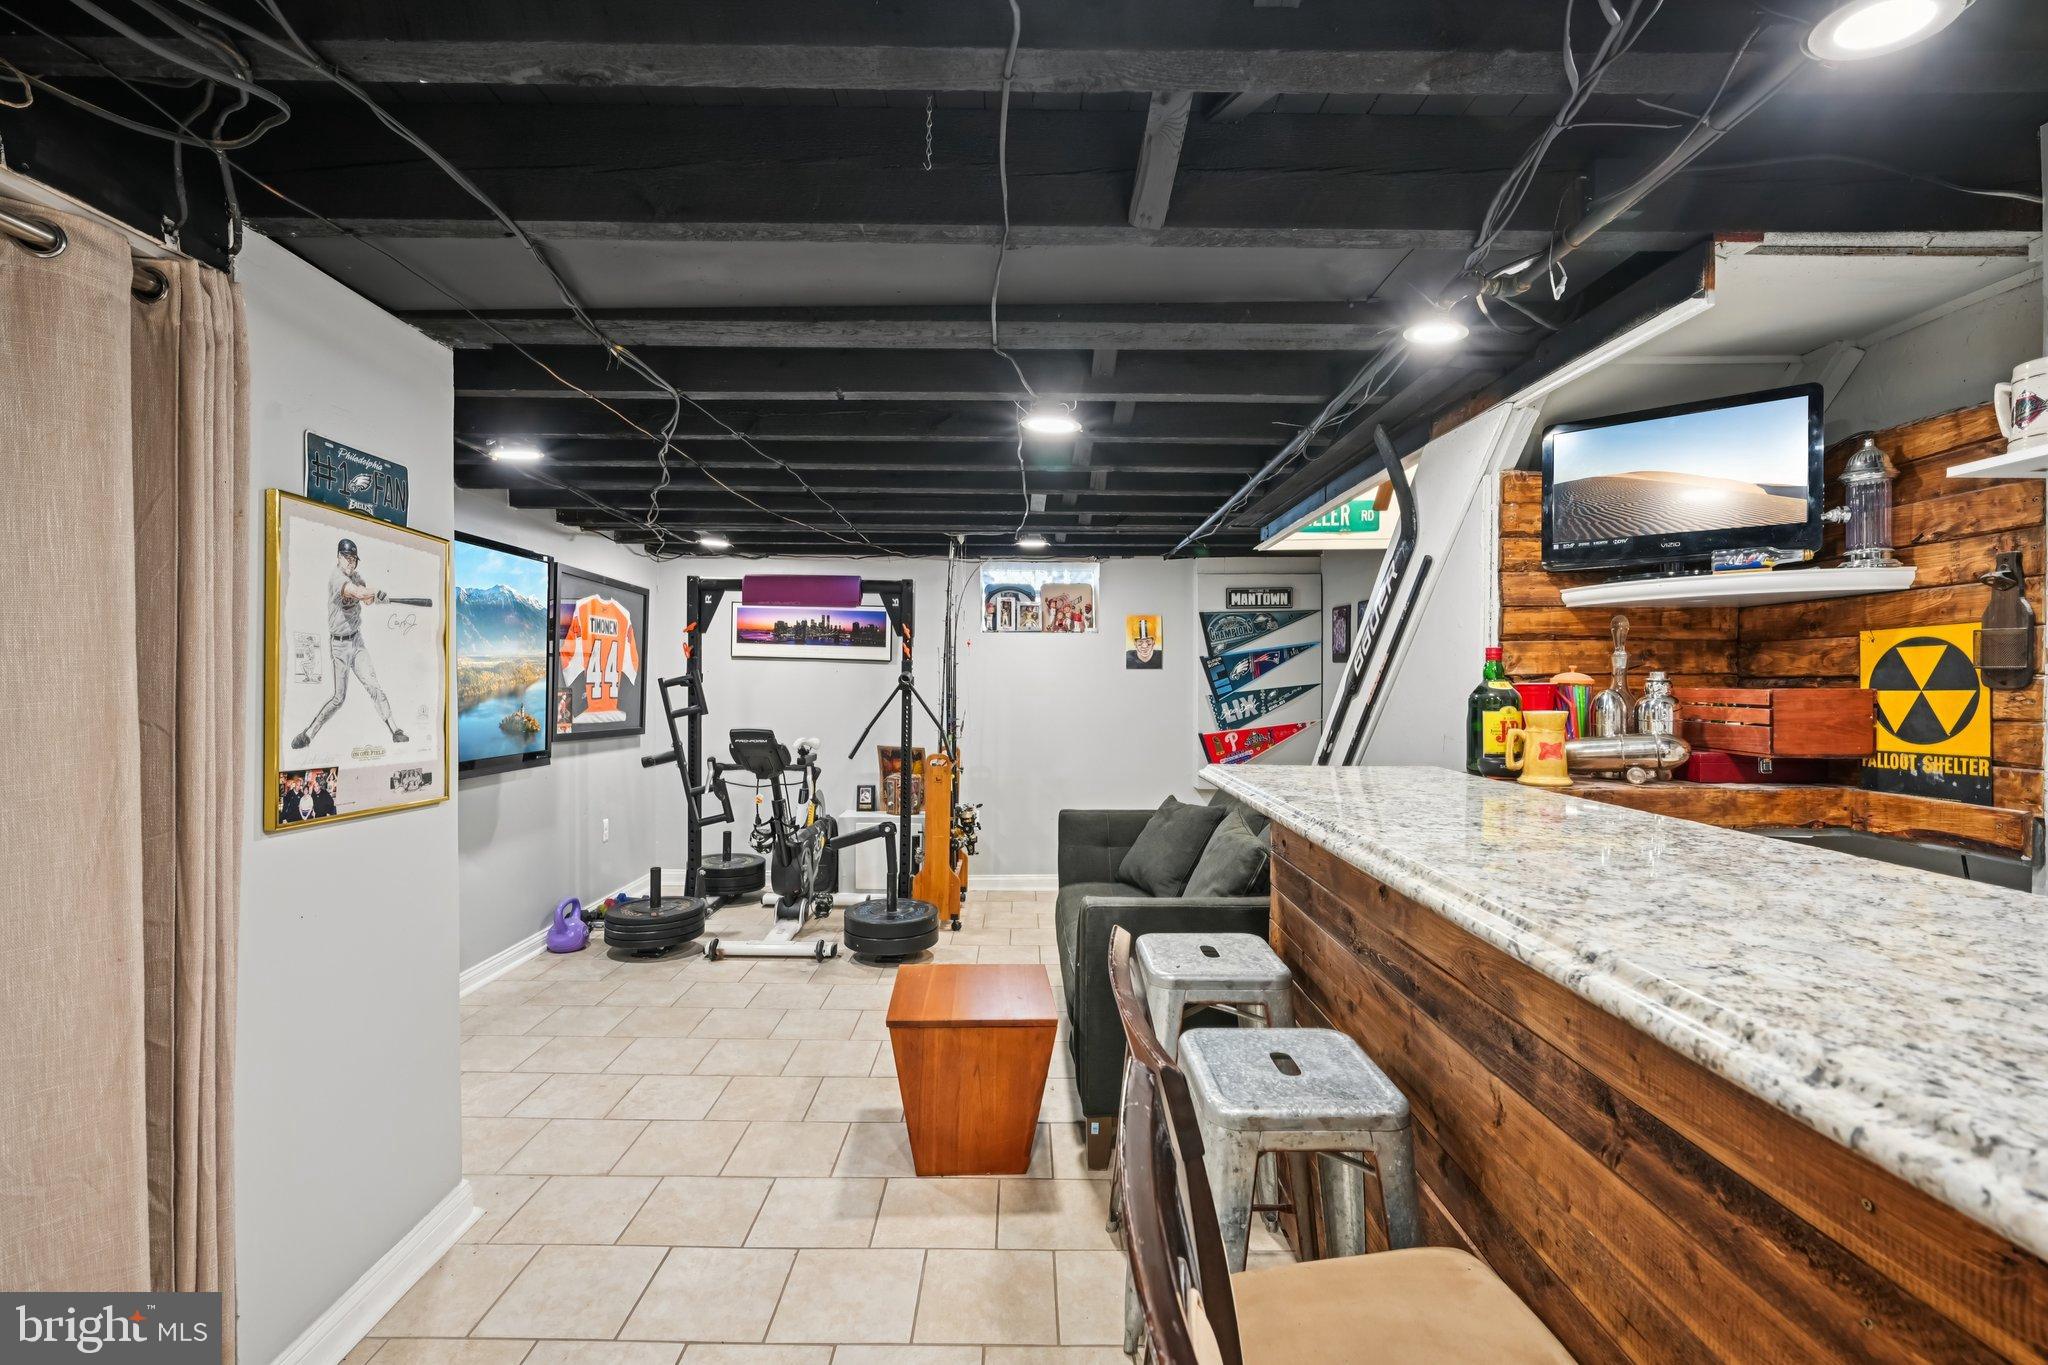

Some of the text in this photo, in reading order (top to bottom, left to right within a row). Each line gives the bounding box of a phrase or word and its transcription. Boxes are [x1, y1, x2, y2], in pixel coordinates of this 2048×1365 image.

[338, 447, 383, 471] Philadelphia
[312, 450, 406, 511] #1 FAN
[348, 499, 374, 516] EAGLES
[1361, 509, 1375, 521] RD
[1231, 592, 1288, 606] MANTOWN
[589, 616, 618, 635] TIMONEN
[1353, 560, 1398, 677] BAUER
[1208, 619, 1254, 642] CHAMPIONS
[586, 638, 620, 699] 44
[1221, 694, 1258, 723] LIX
[1922, 755, 1990, 777] SHELTER
